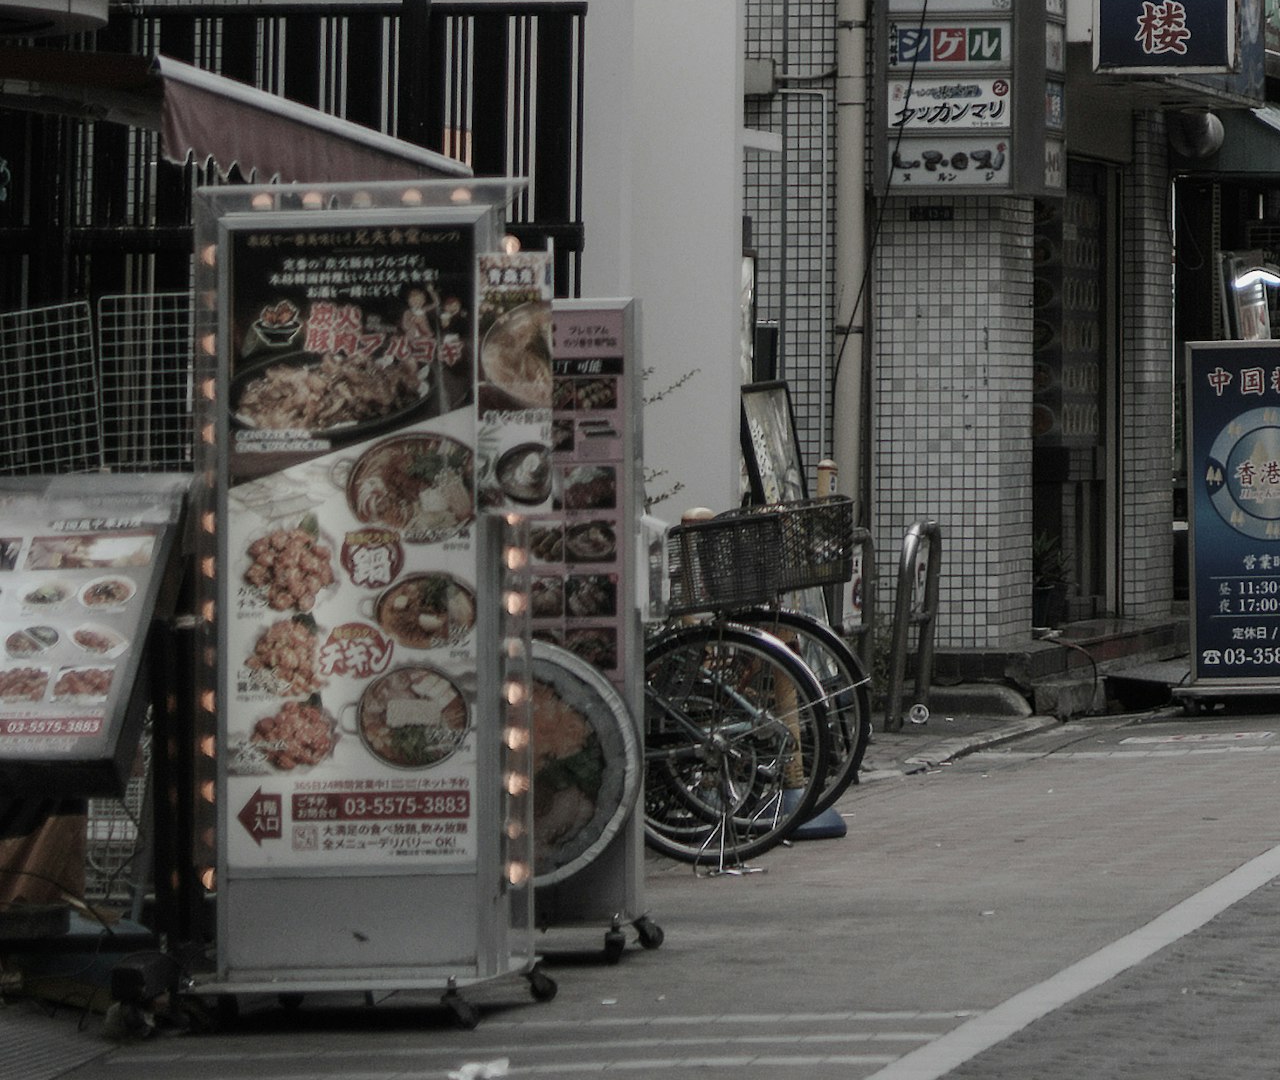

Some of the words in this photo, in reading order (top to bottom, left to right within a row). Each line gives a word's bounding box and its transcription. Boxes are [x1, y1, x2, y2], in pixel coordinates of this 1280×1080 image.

[902, 30, 1000, 60] シゲル
[892, 100, 1005, 127] タッカンマリ
[308, 301, 362, 328] 炭火
[1232, 626, 1267, 642] 定休日
[254, 800, 278, 816] 1階
[297, 795, 327, 808] ご予約
[344, 796, 467, 816] 03-5575-3883
[252, 816, 279, 832] 入口
